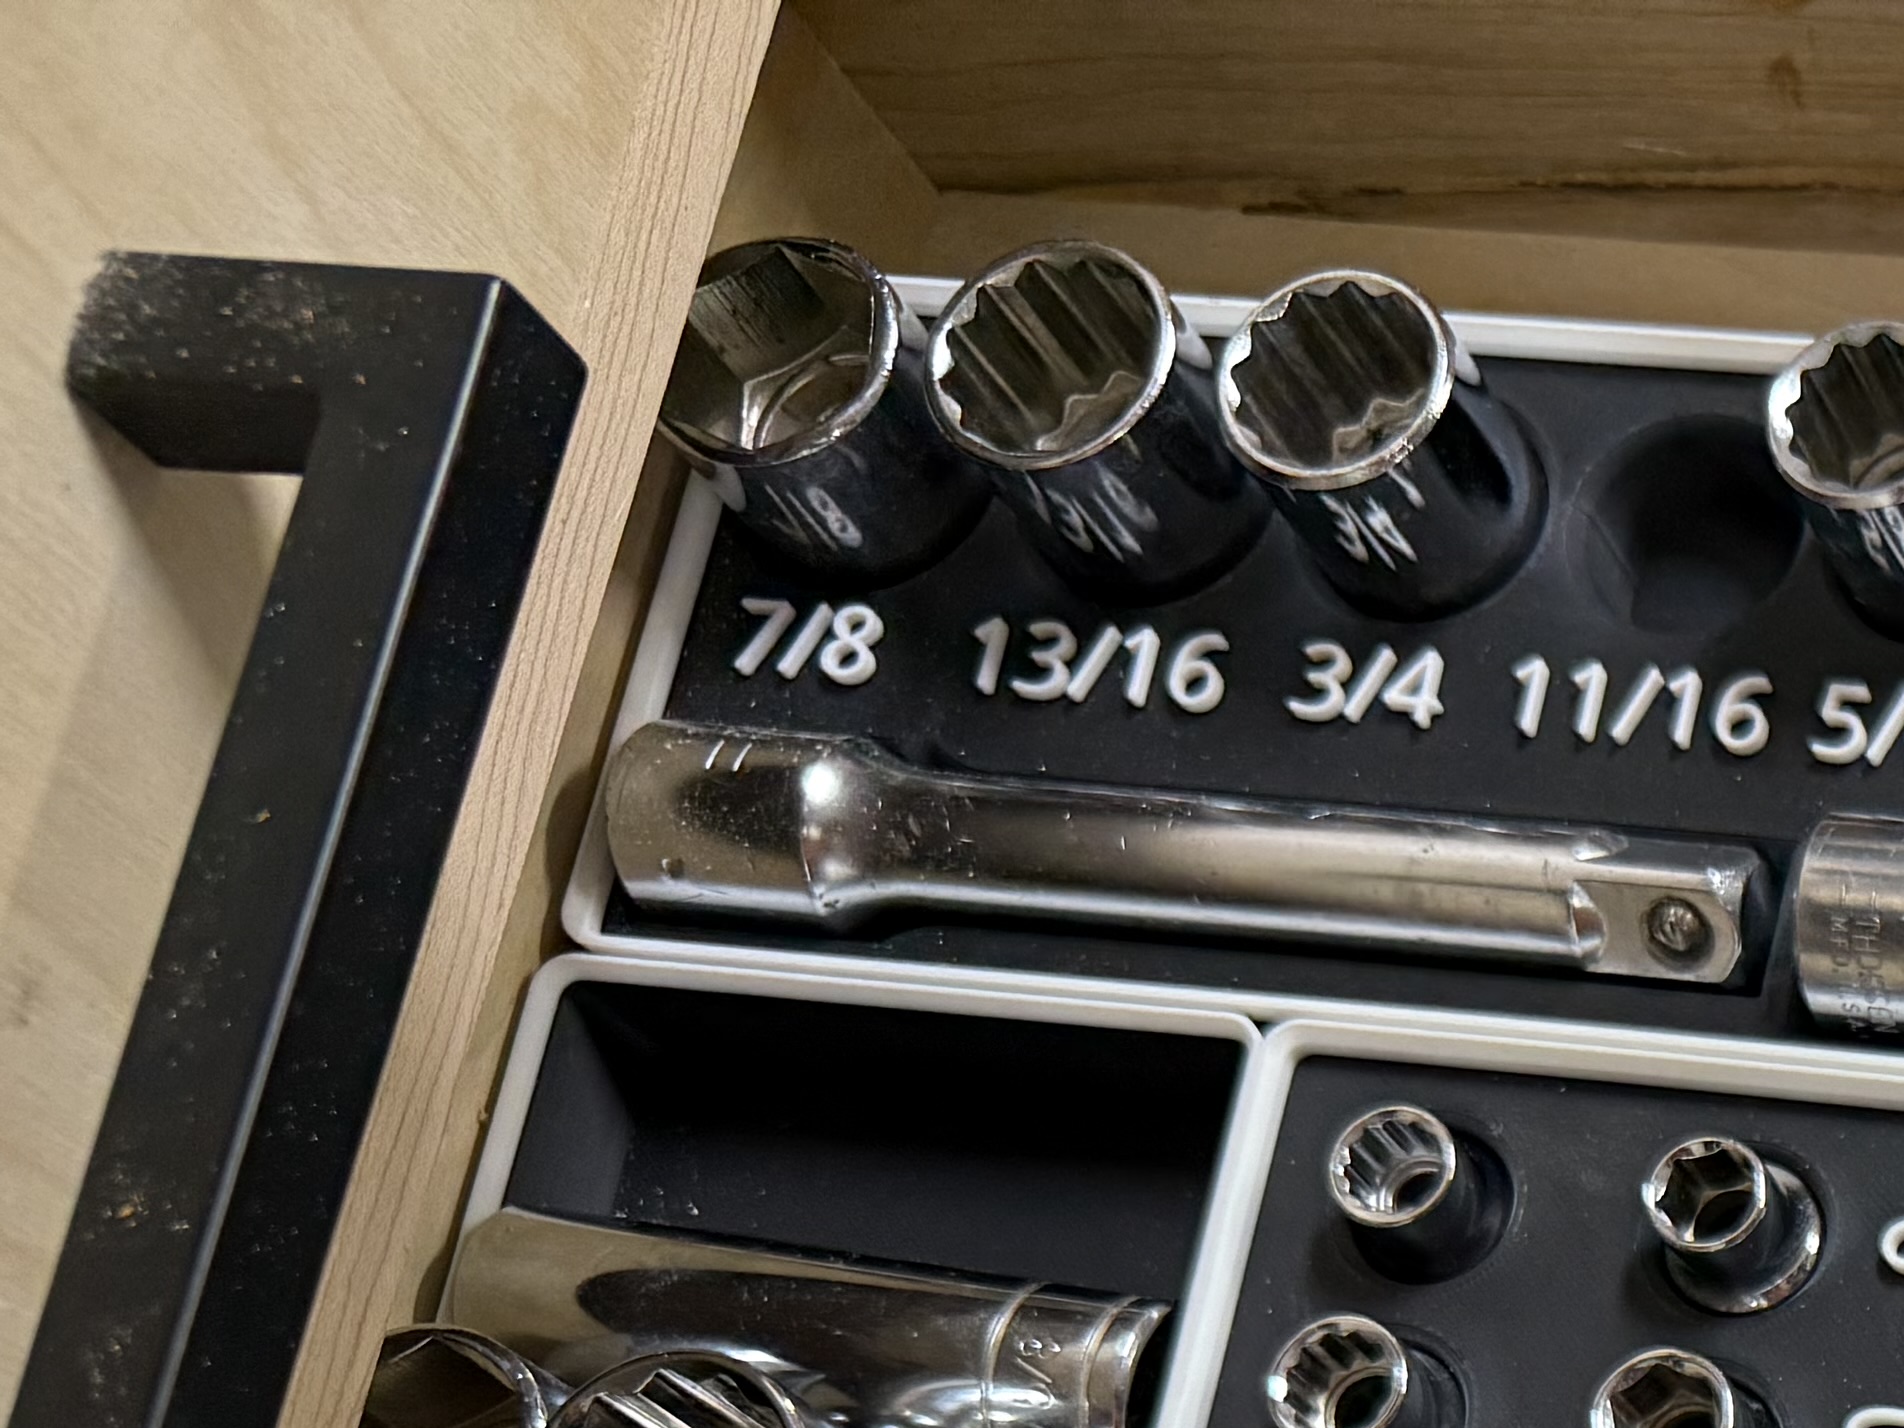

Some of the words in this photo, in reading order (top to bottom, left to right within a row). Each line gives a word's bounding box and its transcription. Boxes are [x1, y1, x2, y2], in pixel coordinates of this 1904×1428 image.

[733, 598, 884, 685] 7/8
[974, 617, 1229, 713] 13/16
[1287, 642, 1445, 729] 3/4
[1514, 655, 1771, 754] 11/16
